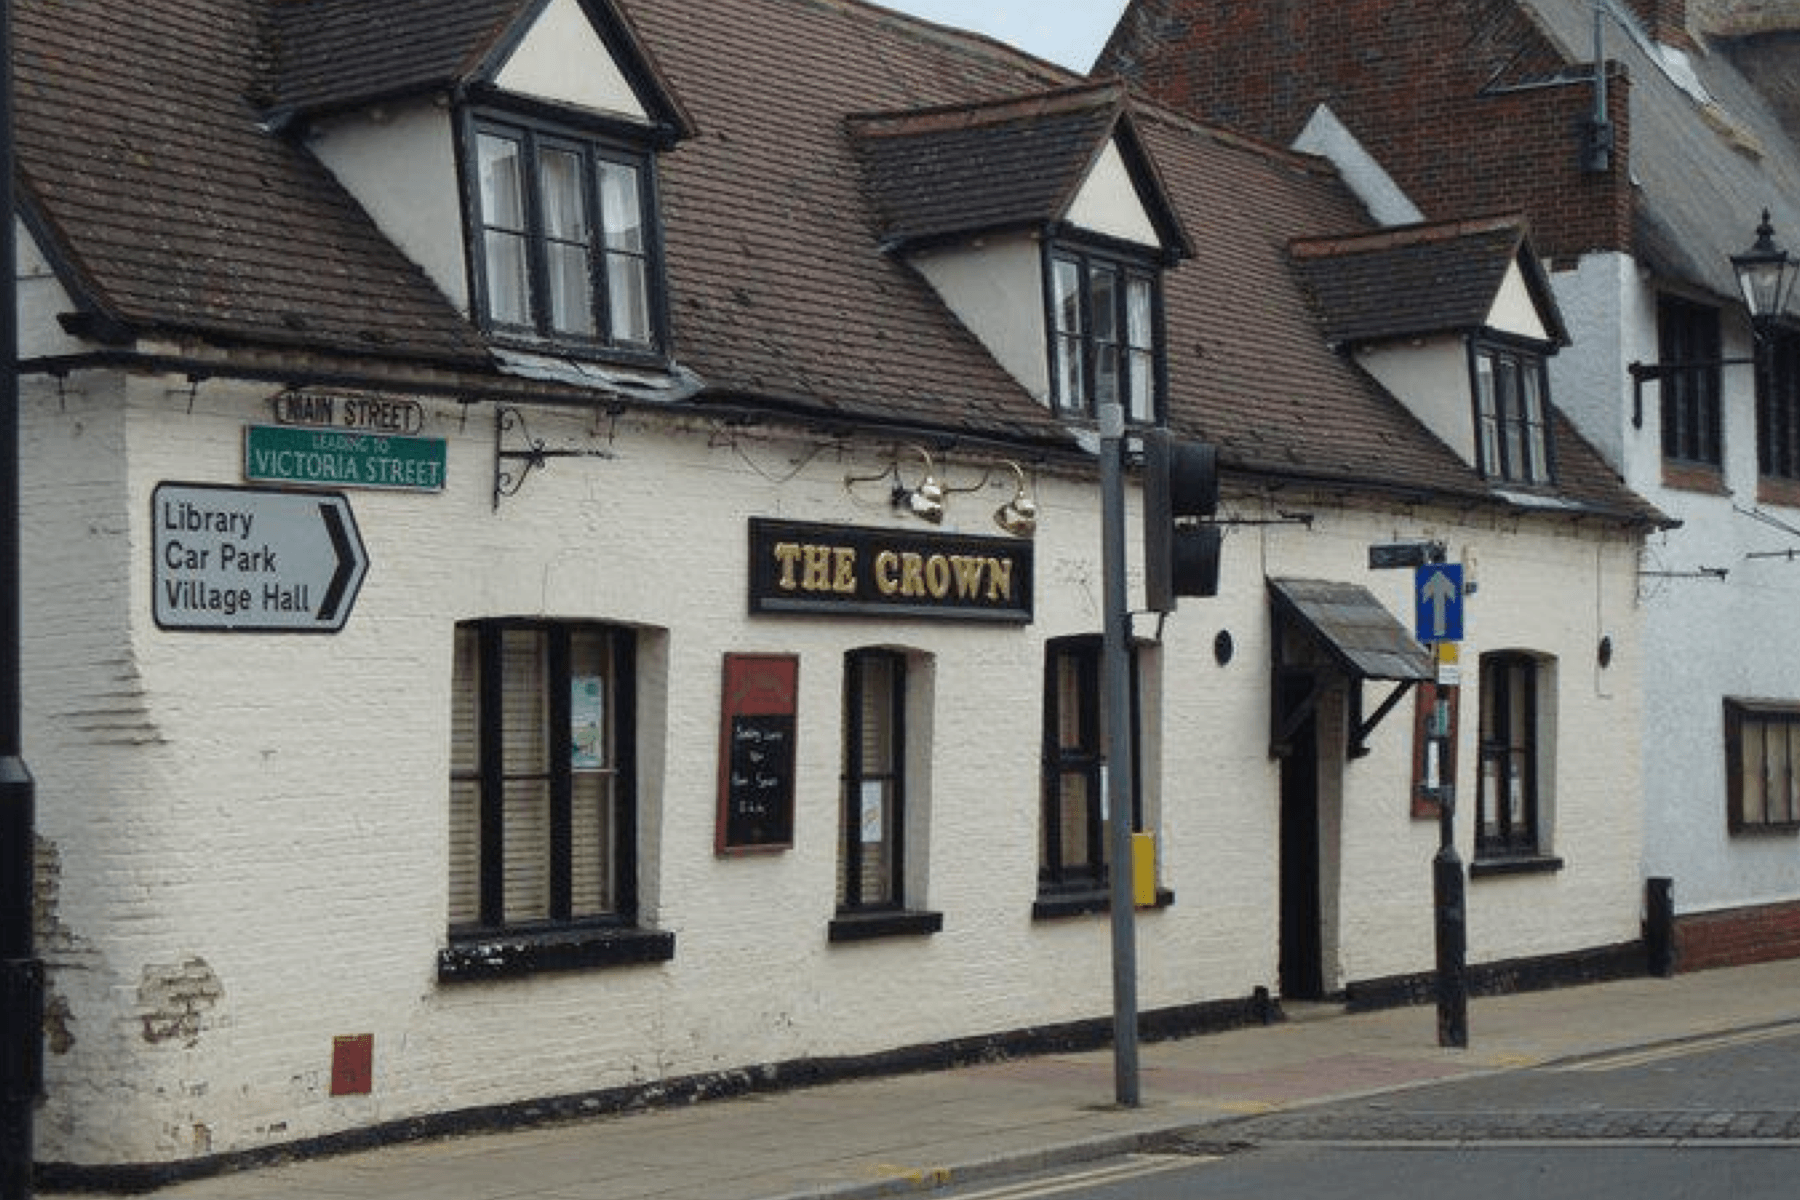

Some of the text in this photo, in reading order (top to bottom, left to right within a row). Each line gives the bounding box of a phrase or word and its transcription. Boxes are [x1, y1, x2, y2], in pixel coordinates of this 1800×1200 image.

[286, 395, 412, 431] MAIN STREET
[255, 449, 442, 485] VICTORIA STREET
[165, 501, 254, 539] Library
[164, 540, 277, 572] Car Park
[774, 542, 1013, 600] THE CROWN
[165, 579, 310, 615] Village Hall
